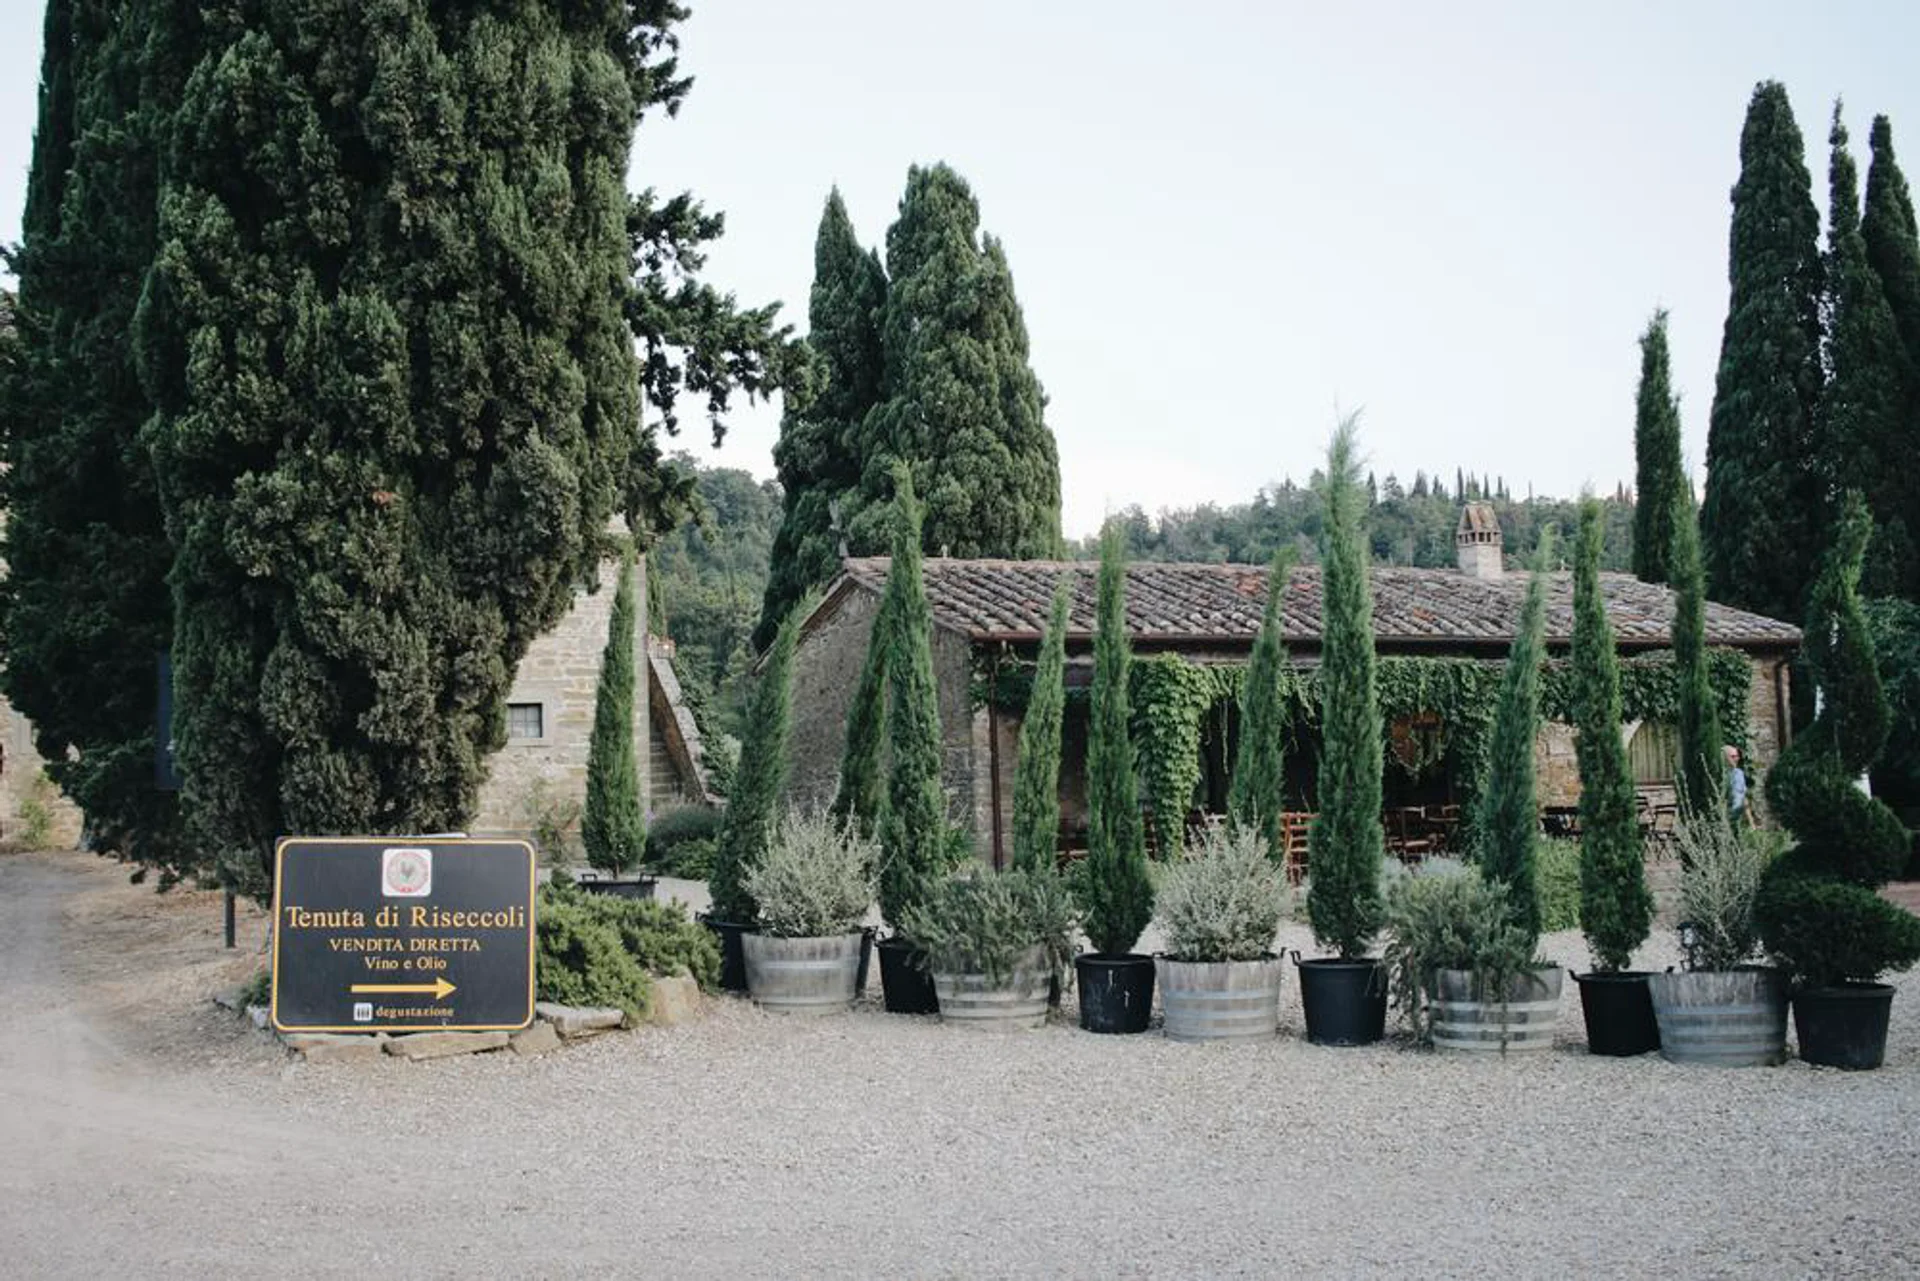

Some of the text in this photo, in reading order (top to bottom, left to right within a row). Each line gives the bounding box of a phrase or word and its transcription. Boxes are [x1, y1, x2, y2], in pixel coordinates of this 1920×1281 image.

[285, 906, 525, 928] Tenuta di Riseccoli
[329, 938, 481, 952] VENDITA DIRETTA
[364, 956, 447, 970] Vino e Olio
[375, 1005, 454, 1019] degustazione
